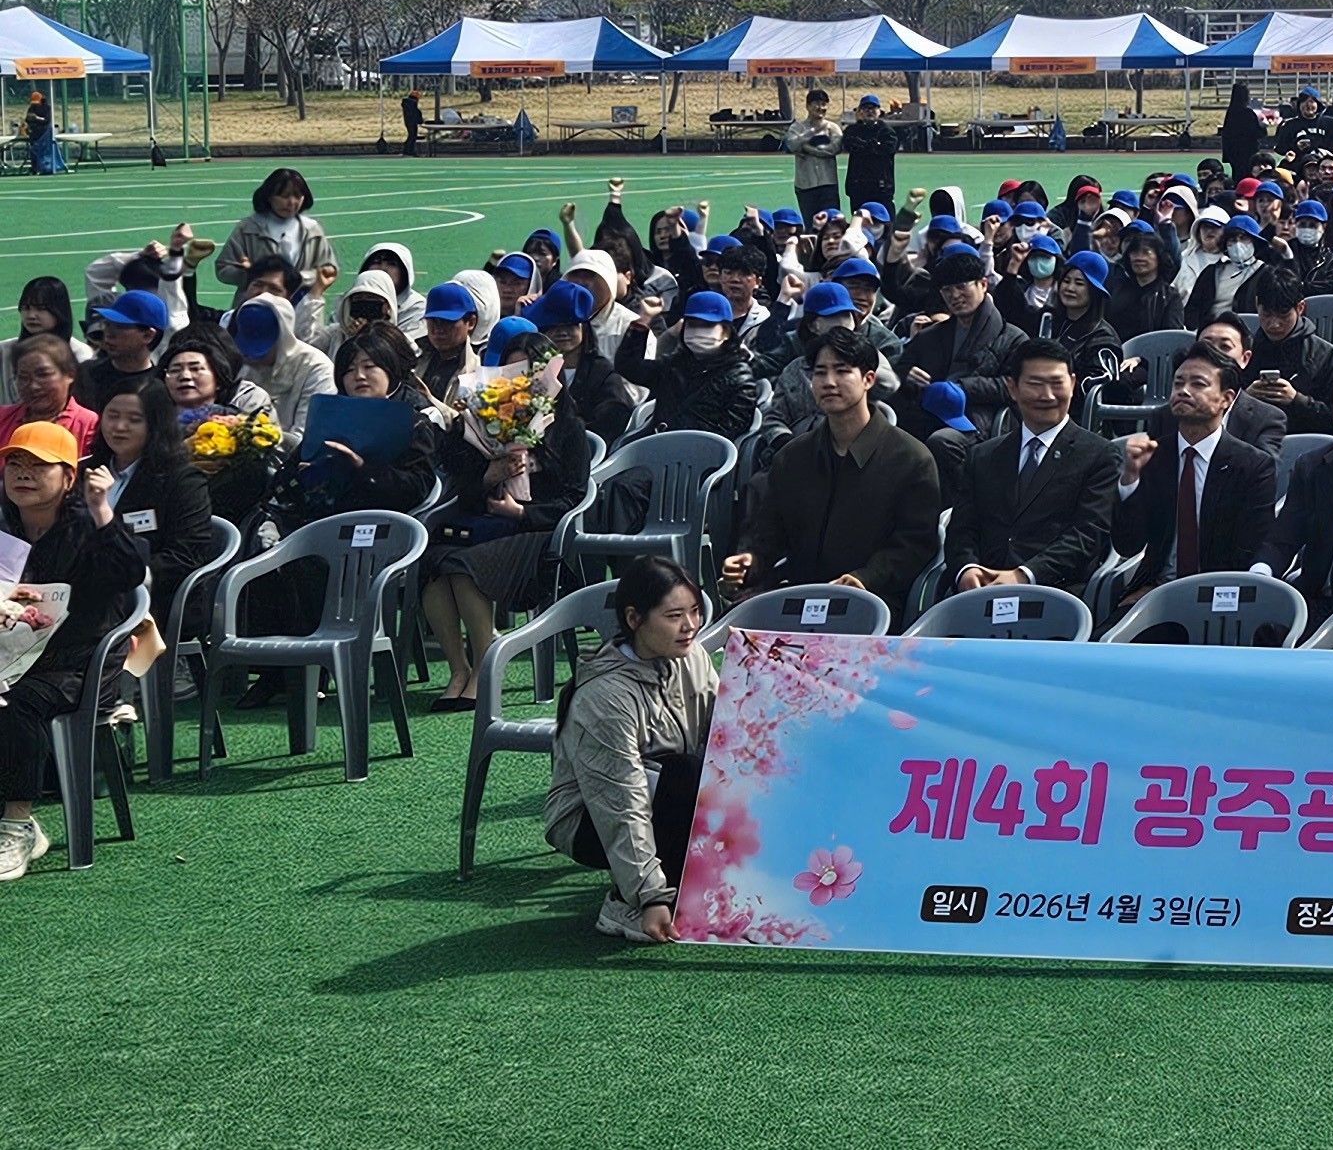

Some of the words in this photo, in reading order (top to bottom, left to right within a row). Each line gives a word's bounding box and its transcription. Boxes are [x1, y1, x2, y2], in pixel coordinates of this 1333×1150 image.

[888, 756, 1110, 846] 제4회
[932, 891, 978, 919] 일시
[995, 890, 1092, 924] 2026년
[1097, 894, 1144, 926] 4월
[1149, 895, 1243, 928] 3일(금)
